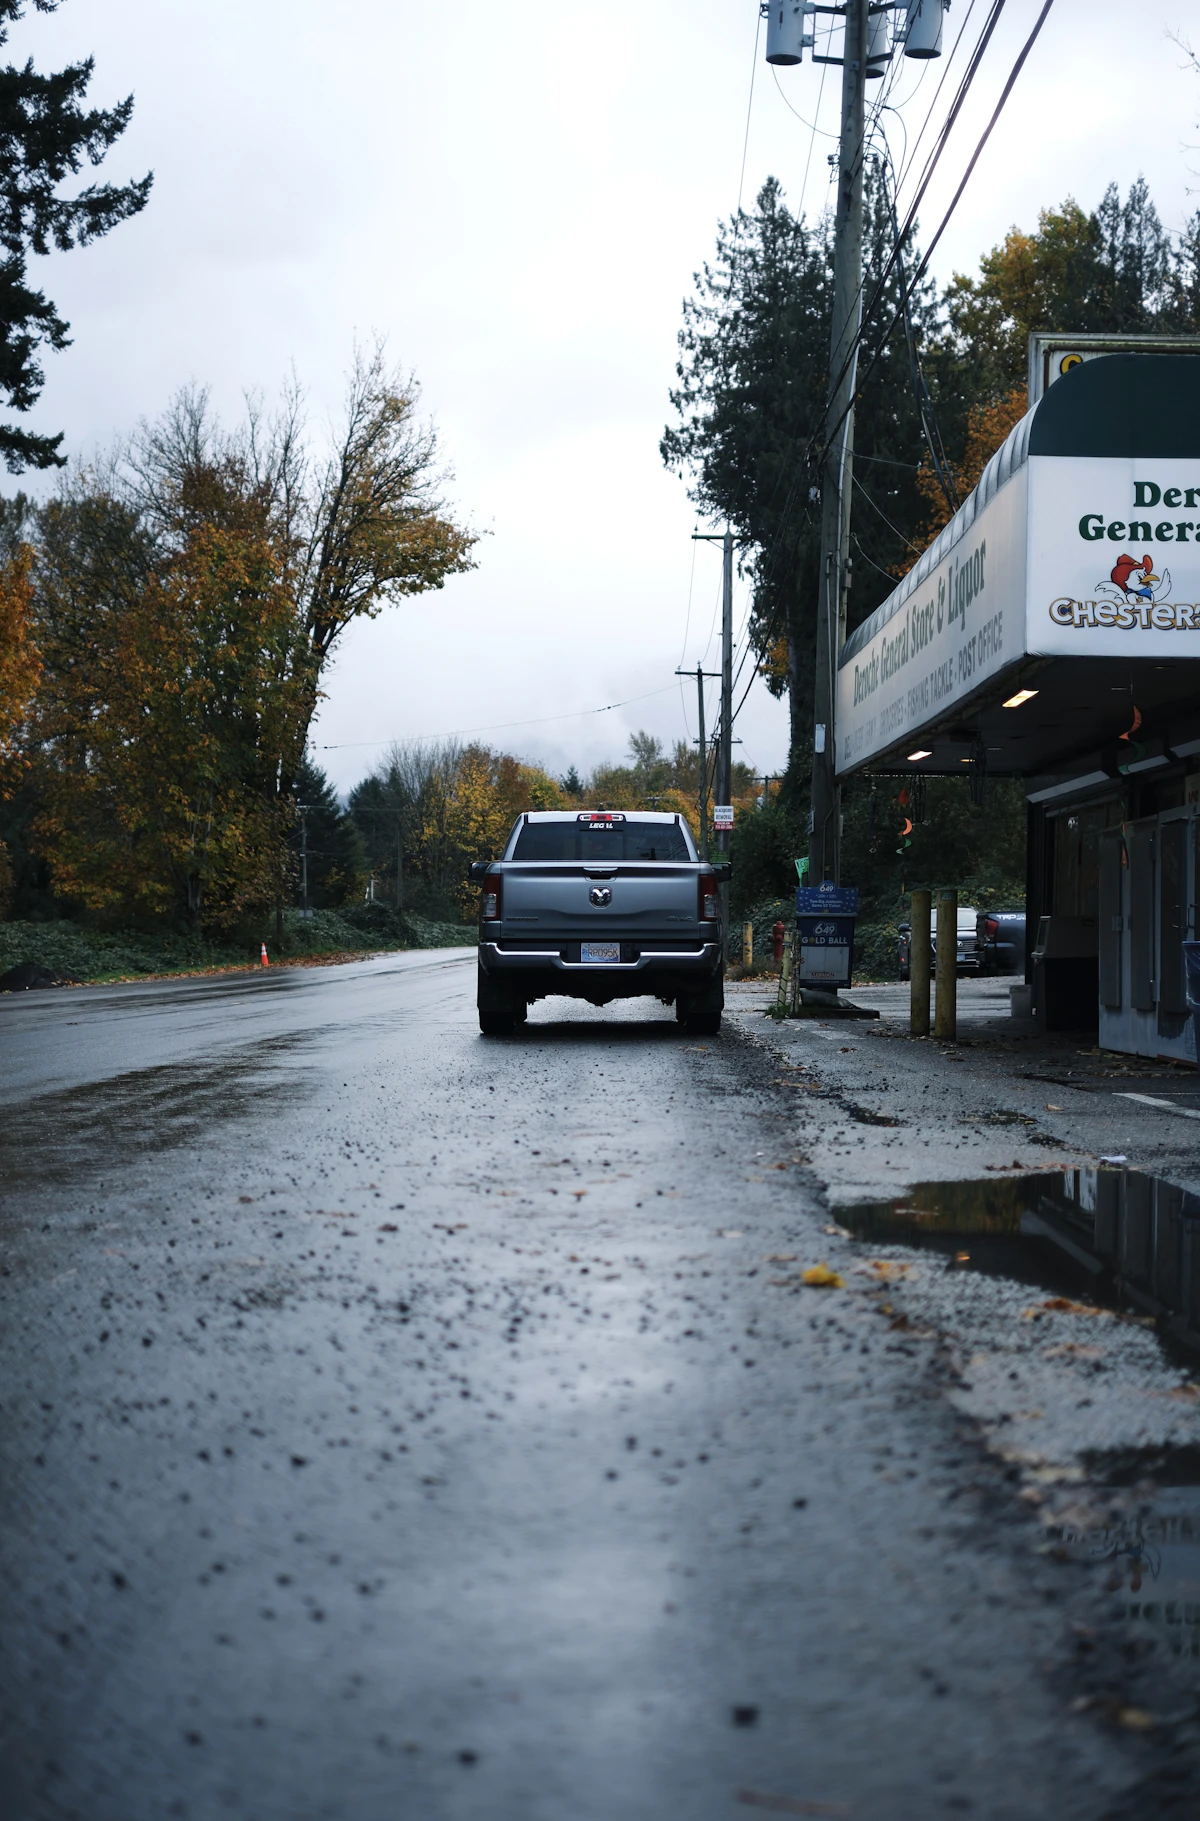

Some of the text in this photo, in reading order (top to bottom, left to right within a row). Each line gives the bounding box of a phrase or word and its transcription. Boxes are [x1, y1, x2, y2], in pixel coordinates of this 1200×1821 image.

[1133, 481, 1200, 508] Der
[853, 538, 987, 708] Deroche General Store & Liquor
[908, 677, 929, 721] FISHING
[930, 657, 954, 704] TACKLE
[959, 635, 977, 684] POST
[978, 610, 1003, 667] OFFICE
[819, 884, 834, 892] 649
[814, 923, 836, 935] 649
[828, 936, 848, 944] BALL
